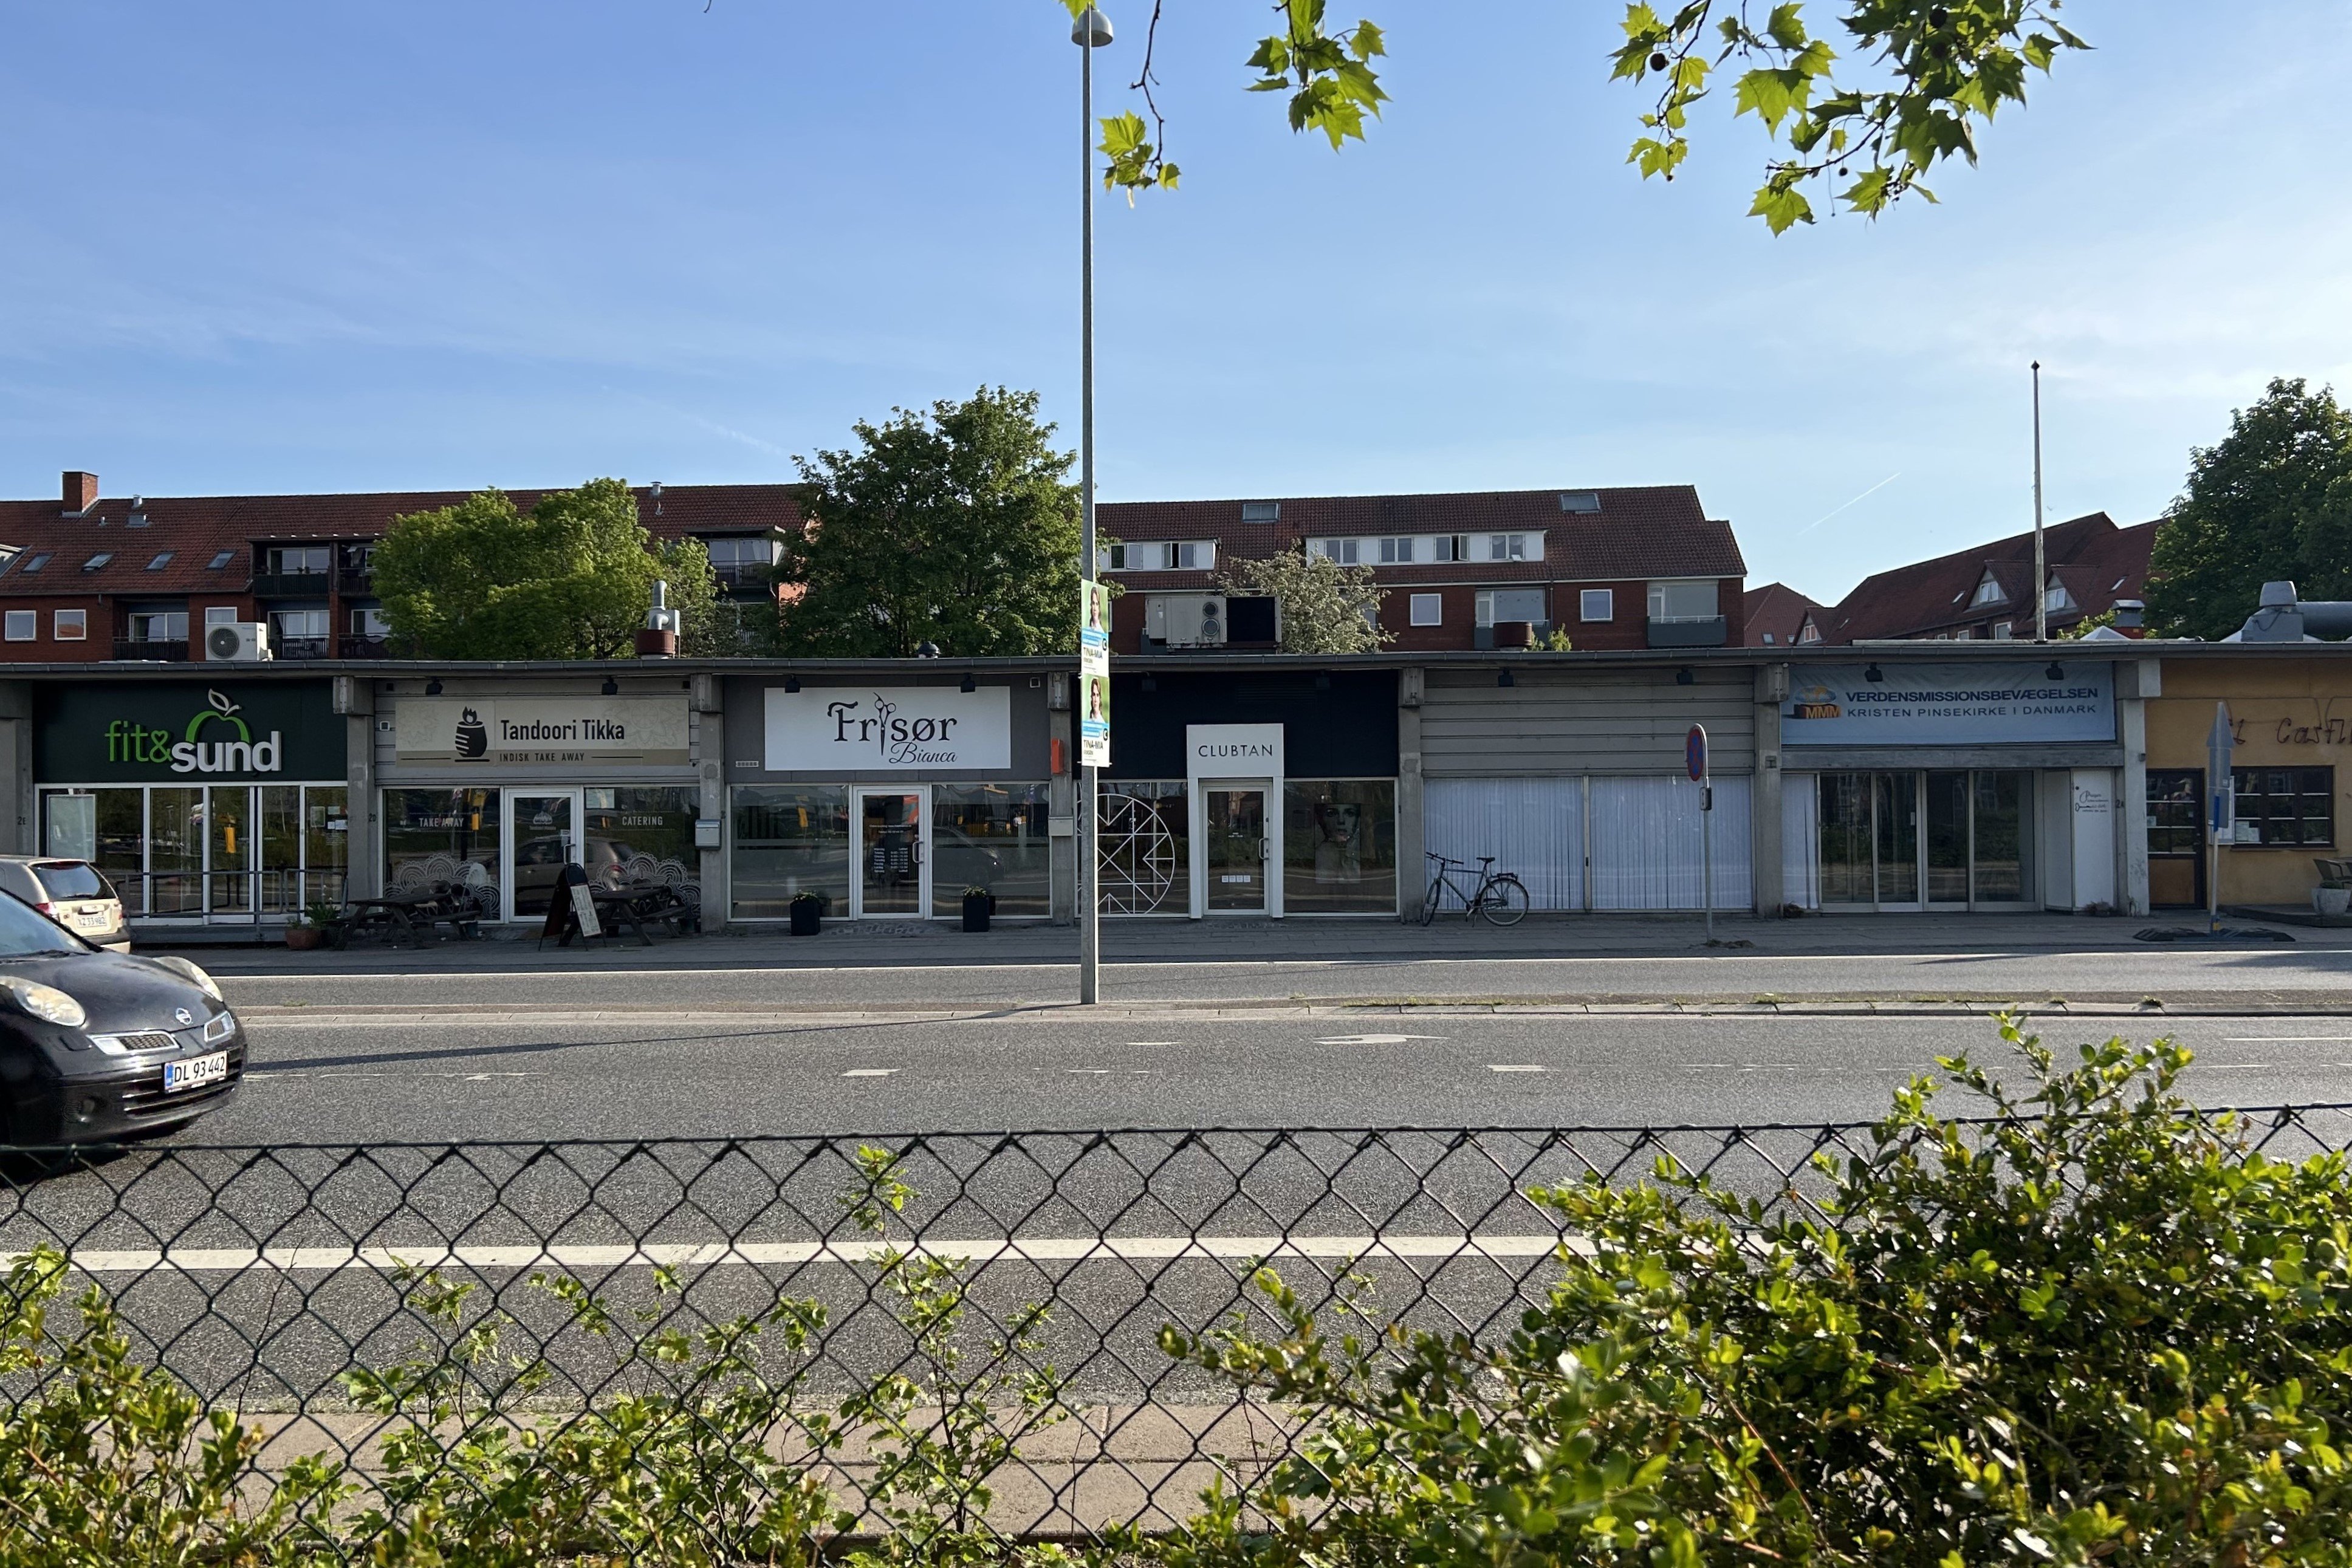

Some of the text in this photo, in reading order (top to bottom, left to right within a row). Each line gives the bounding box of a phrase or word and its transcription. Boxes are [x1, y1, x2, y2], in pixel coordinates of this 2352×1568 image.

[1846, 688, 2098, 702] VERDENSMISSIONSBEVÆGELSEN
[1805, 705, 1841, 719] MMM
[1848, 708, 1911, 717] KRISTEN
[1918, 707, 2006, 717] PINSEKIRKE
[2023, 705, 2096, 714] DANMARK
[501, 719, 625, 740] Tandoori Tikka
[105, 721, 282, 773] fit& sund
[1083, 739, 1103, 750] TINA-MIA
[1198, 744, 1273, 757] CLUBTAN
[499, 753, 585, 762] INDISK TAKE AWAY
[889, 741, 958, 764] Bianca
[419, 818, 464, 827] TAKE AWAY
[622, 816, 663, 826] CATERING
[174, 1056, 225, 1083] DL 93 442
